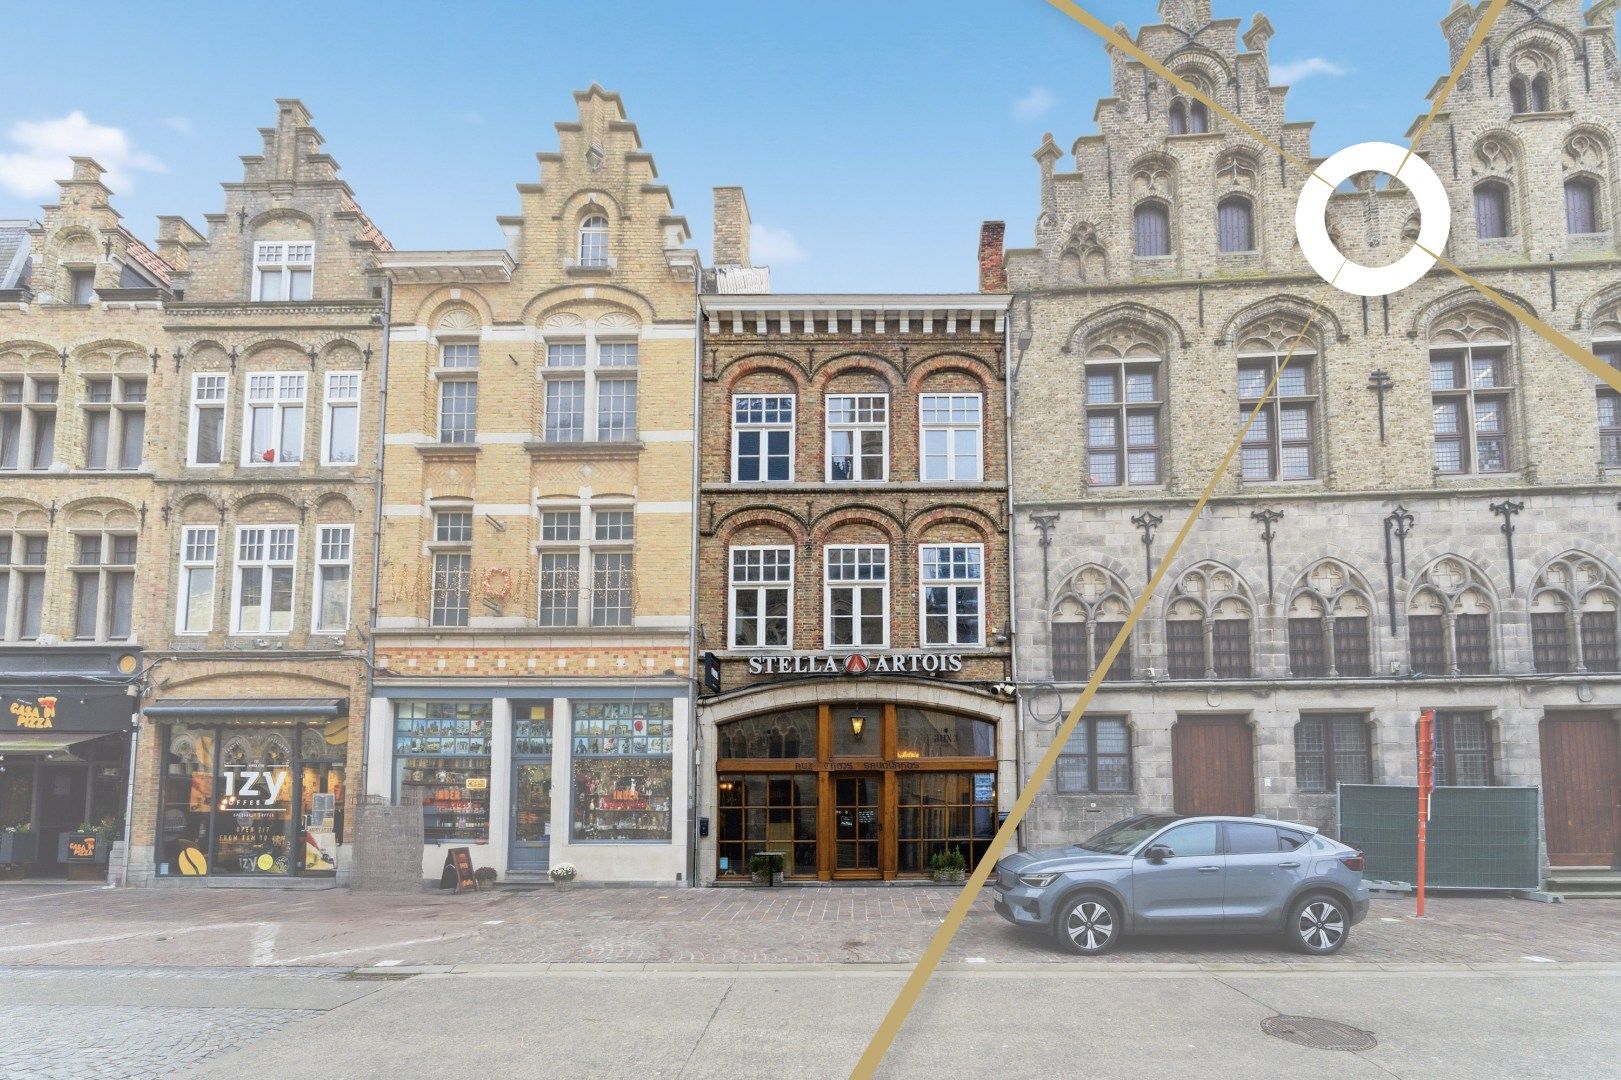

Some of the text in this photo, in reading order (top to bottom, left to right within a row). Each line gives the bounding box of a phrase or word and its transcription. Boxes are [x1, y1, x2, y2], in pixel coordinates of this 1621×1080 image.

[749, 654, 962, 675] STELLA ARTOIS
[16, 714, 53, 728] PIZZA
